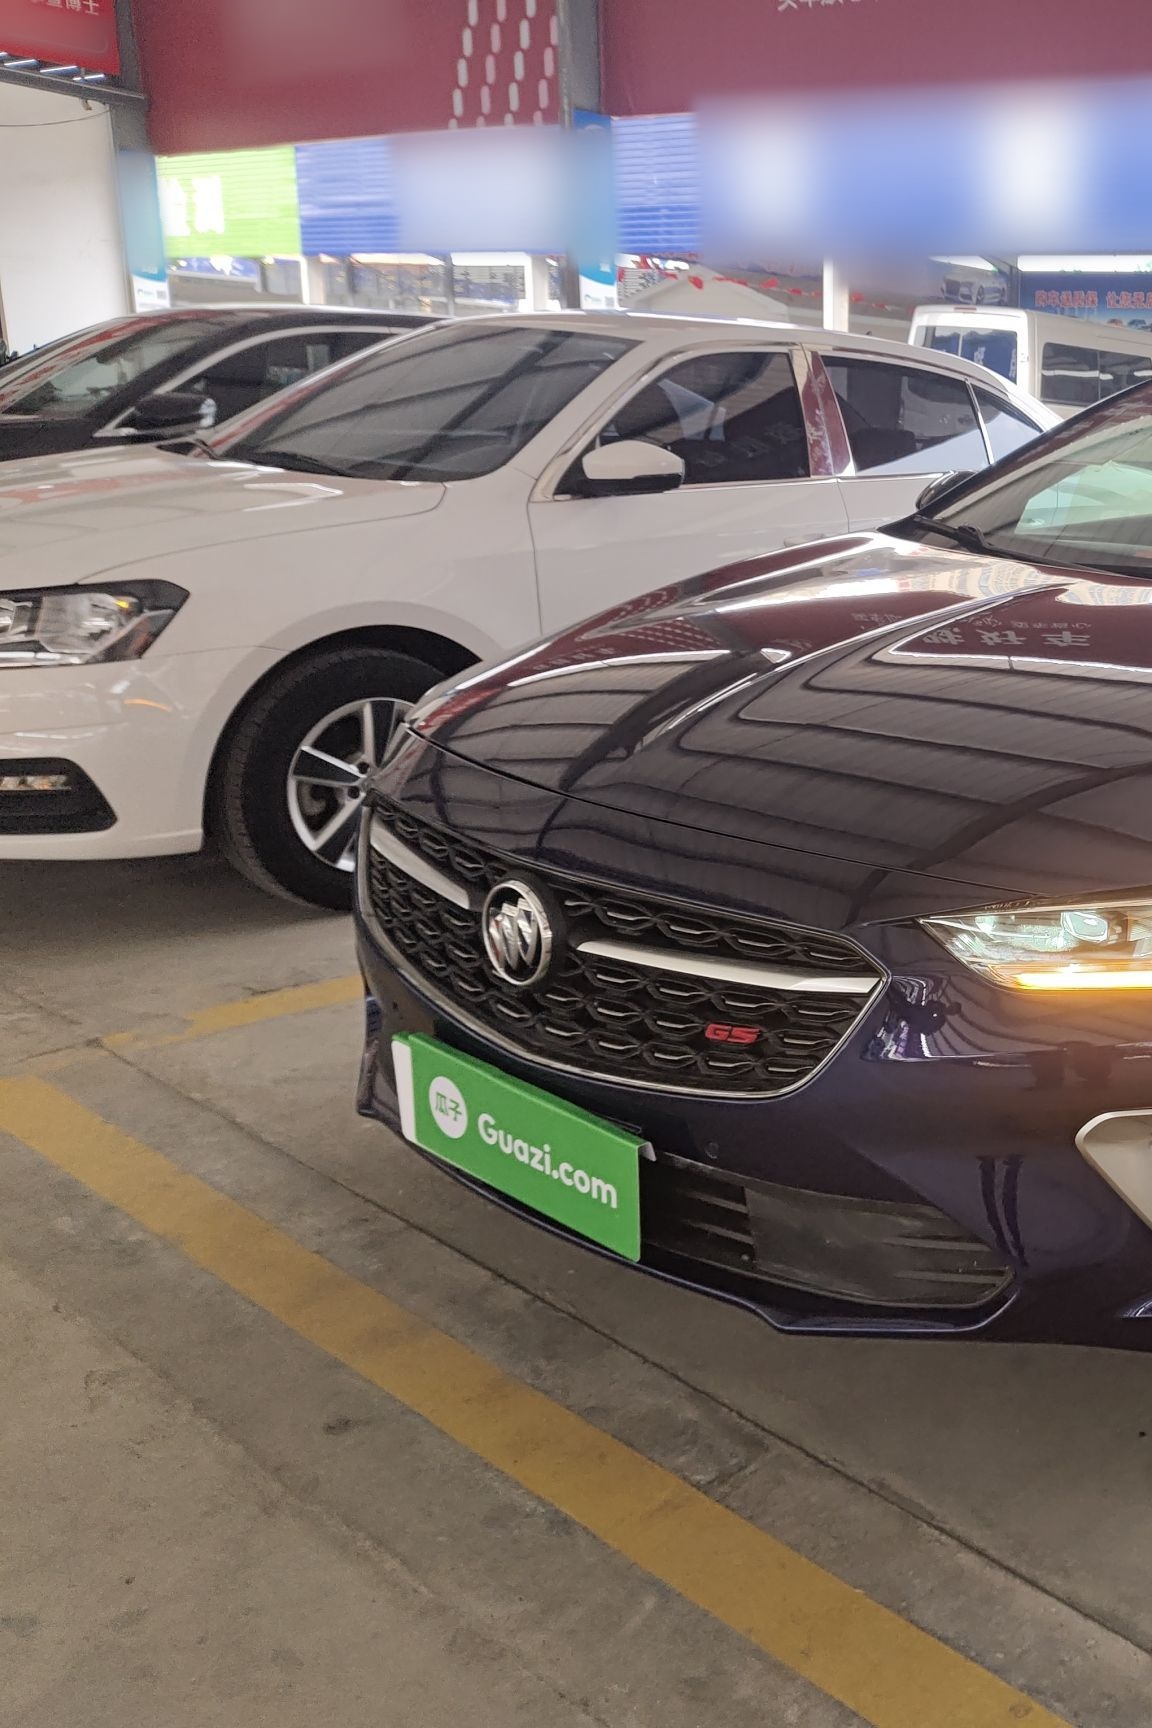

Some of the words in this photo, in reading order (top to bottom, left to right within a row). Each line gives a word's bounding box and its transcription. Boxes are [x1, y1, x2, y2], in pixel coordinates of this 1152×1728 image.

[705, 1023, 760, 1044] GS
[435, 1092, 463, 1121] 瓜子
[478, 1112, 617, 1209] Guazi.com
